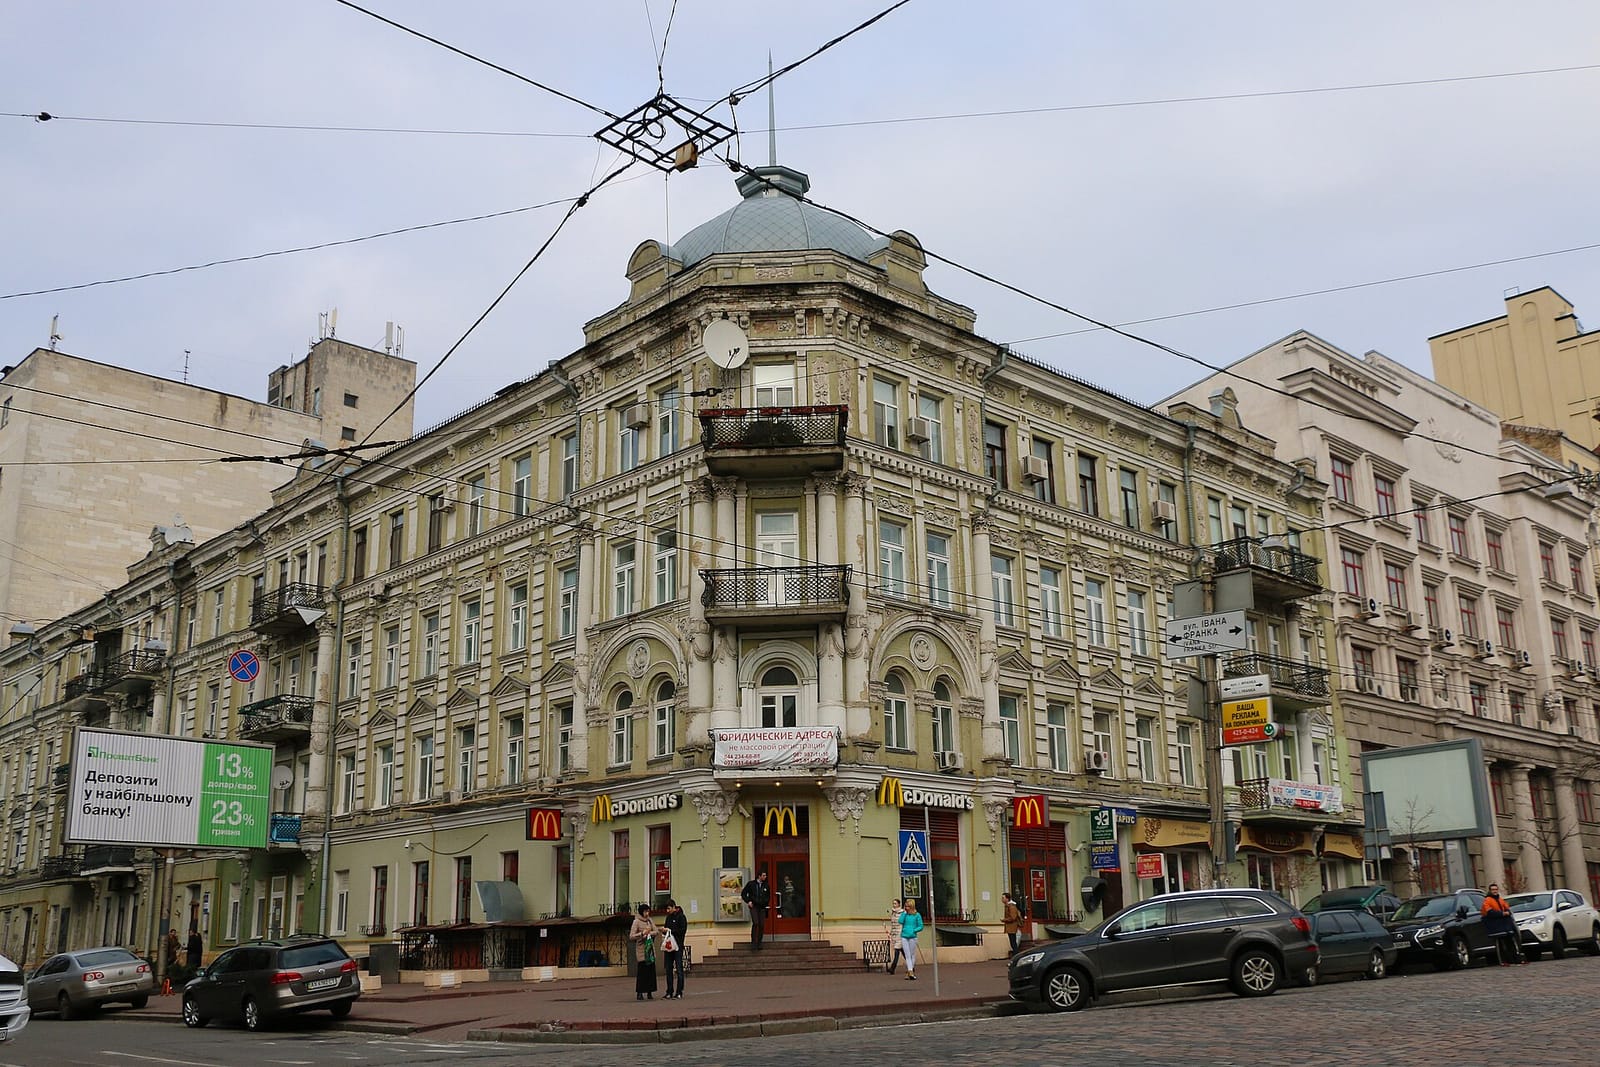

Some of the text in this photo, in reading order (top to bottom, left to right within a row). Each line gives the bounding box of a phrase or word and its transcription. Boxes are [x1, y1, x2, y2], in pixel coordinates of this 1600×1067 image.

[1201, 617, 1227, 627] ІВАНА
[1183, 628, 1218, 639] ФРАНКА
[1236, 703, 1254, 711] ВАША
[1231, 711, 1260, 720] РЕКЛАМА
[719, 730, 834, 743] ЮРИДИЧЕСКИЕ АДРЕСА
[740, 743, 776, 751] массовой
[216, 753, 254, 779] 13%
[84, 770, 159, 786] Депозити
[84, 788, 193, 806] у найбільшому
[879, 777, 975, 809] McDonald's
[82, 803, 131, 819] банку!
[211, 800, 255, 826] 23%
[591, 794, 678, 823] McDonald's
